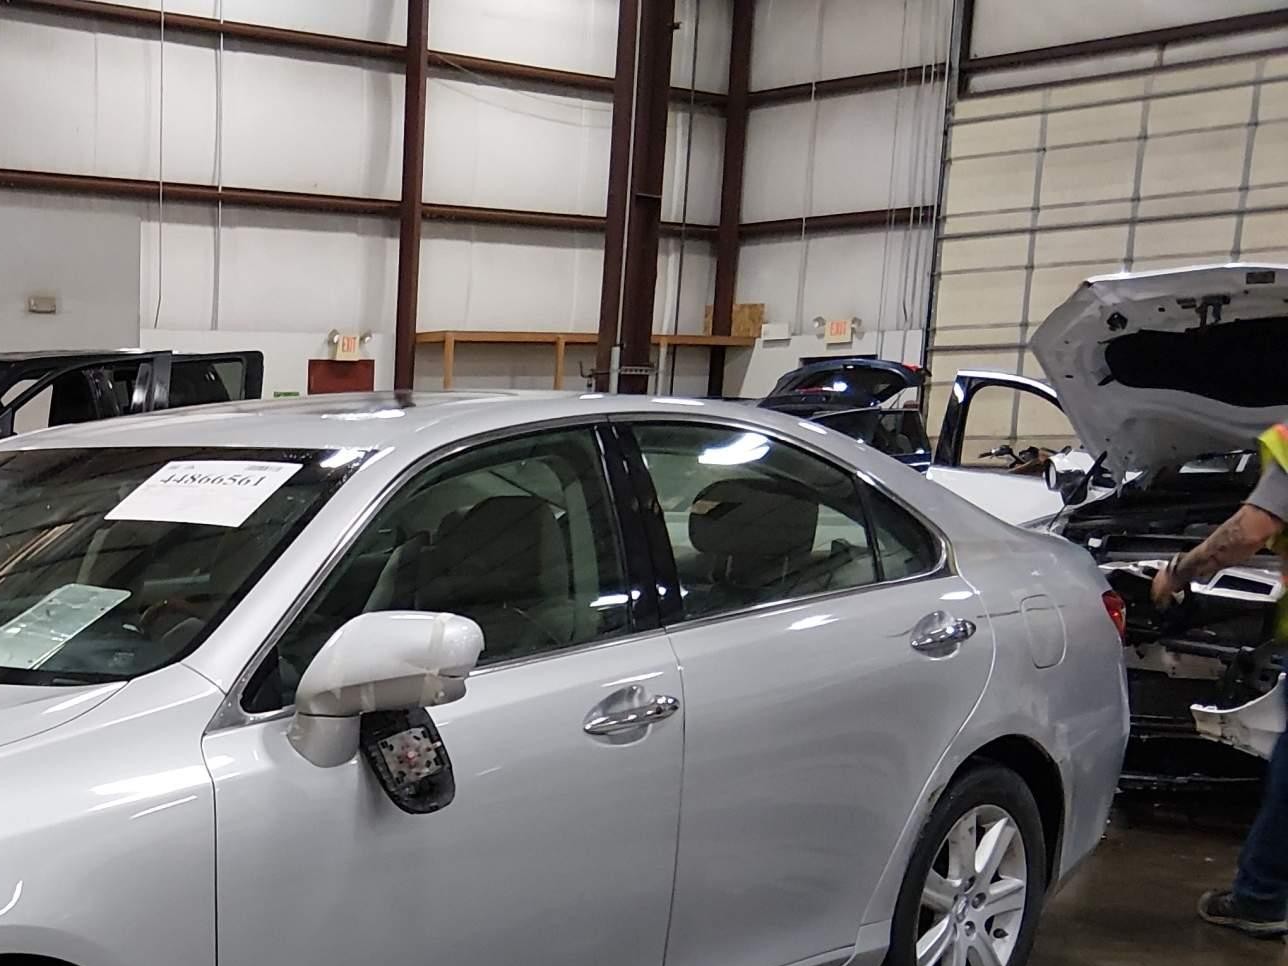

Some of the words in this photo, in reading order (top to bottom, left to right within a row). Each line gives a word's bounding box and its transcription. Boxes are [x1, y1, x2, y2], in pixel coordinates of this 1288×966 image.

[830, 320, 847, 336] EXIT
[342, 336, 357, 352] EXIT
[160, 473, 266, 487] 44866561
